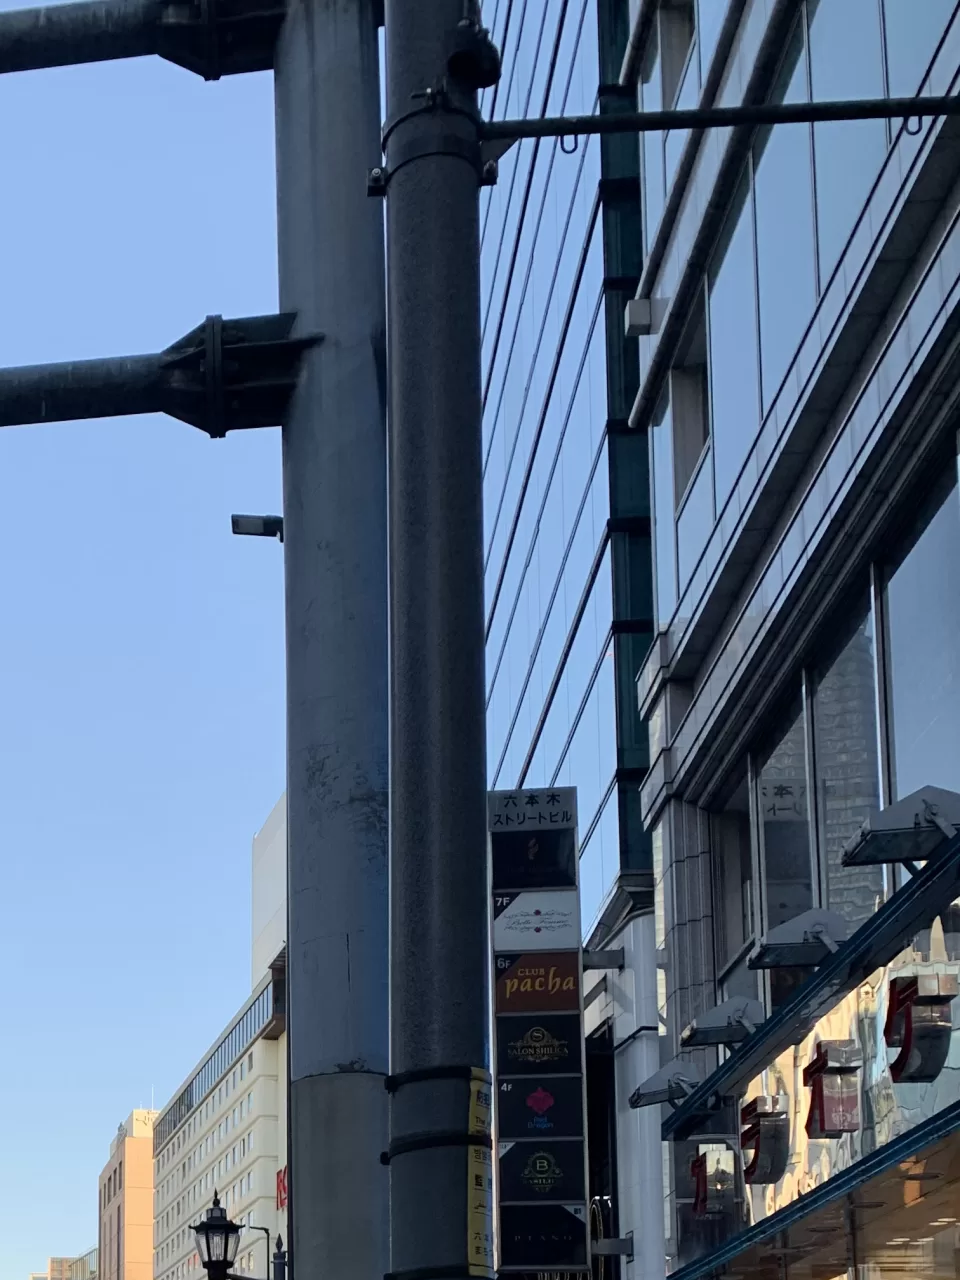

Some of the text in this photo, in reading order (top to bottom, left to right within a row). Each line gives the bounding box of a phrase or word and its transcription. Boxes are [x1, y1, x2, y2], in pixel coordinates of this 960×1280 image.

[503, 793, 561, 808] 六本木
[493, 810, 573, 826] ストリートビル
[496, 897, 510, 907] 7F
[497, 958, 511, 969] 6F
[518, 968, 545, 976] CLUB
[505, 967, 577, 999] pacha
[501, 1083, 512, 1092] 4F
